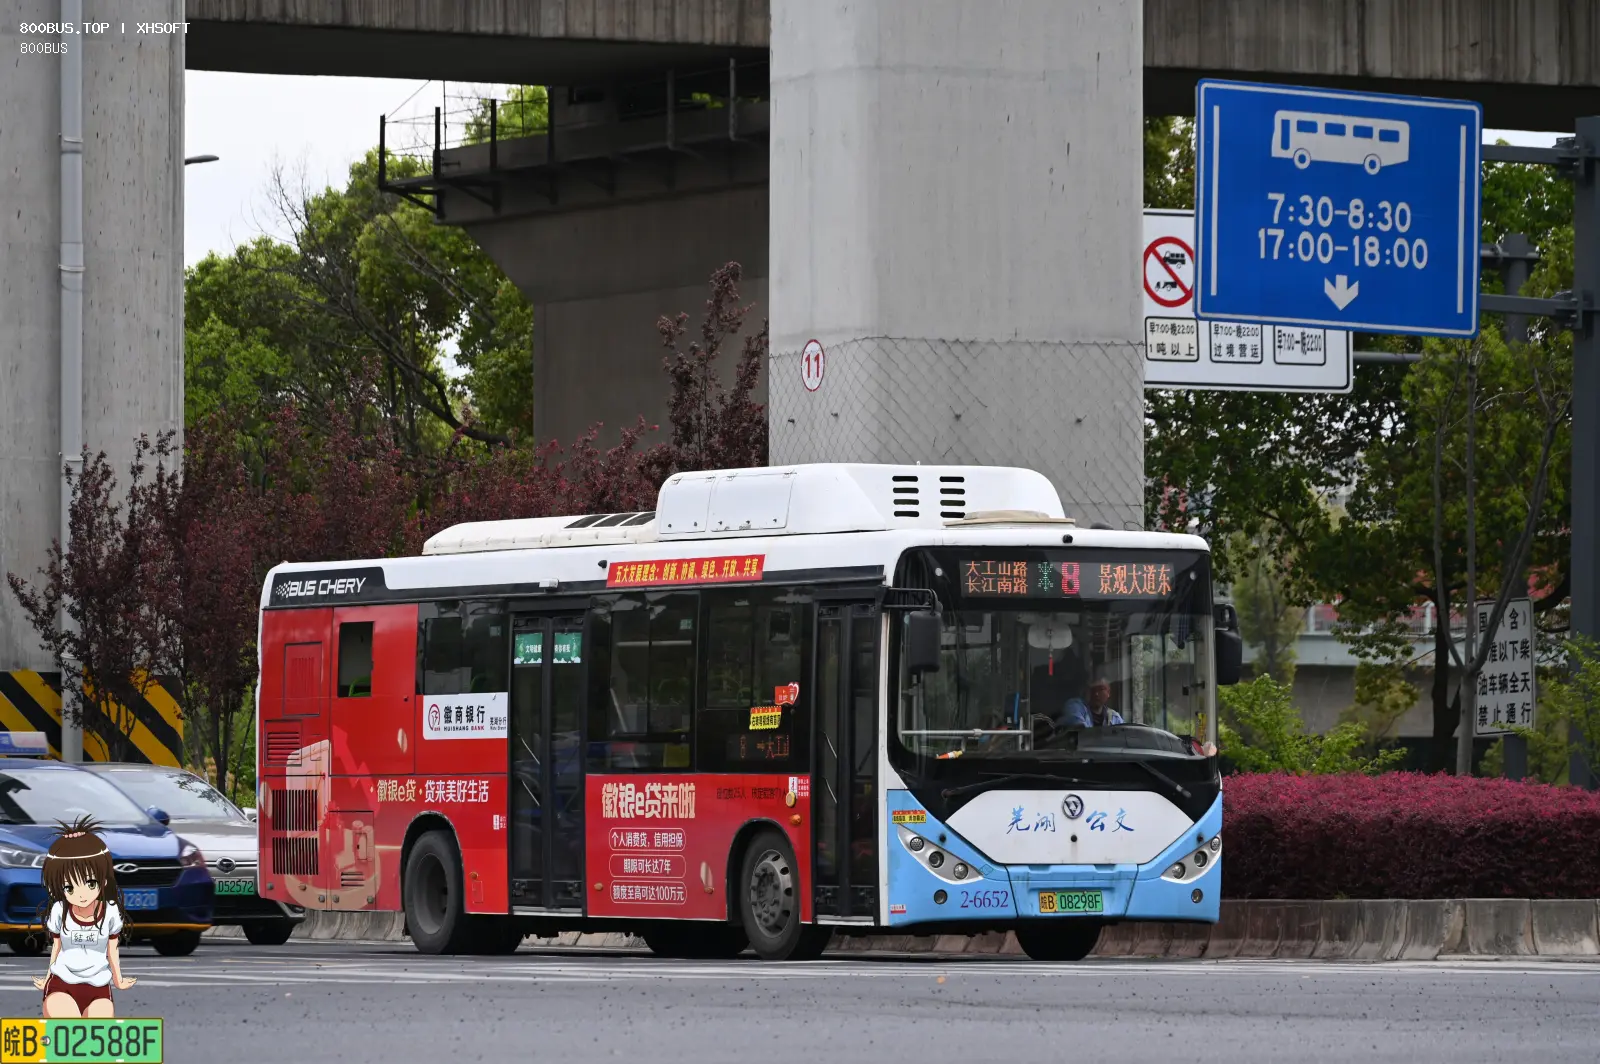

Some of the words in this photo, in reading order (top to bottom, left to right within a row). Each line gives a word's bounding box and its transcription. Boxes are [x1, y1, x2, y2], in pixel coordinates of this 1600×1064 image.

[1267, 192, 1412, 234] 7:30-8:30
[1258, 227, 1429, 270] 17:00-18:00
[1213, 343, 1260, 359] 过境营运
[805, 353, 820, 379] 11
[965, 561, 1028, 577] 大工山路
[1061, 562, 1081, 595] 8
[1098, 564, 1172, 595] 景观大道东
[288, 580, 318, 597] BUS
[318, 577, 367, 595] CHERY
[965, 577, 1028, 594] 长江南路
[1478, 671, 1531, 695] 油车辆全天
[443, 705, 486, 724] 徽商银行
[1478, 702, 1532, 726] 禁止通行
[377, 779, 416, 802] 徽银e贷
[424, 780, 489, 803] 贷来美好生活
[601, 782, 696, 819] 徽银e贷来啦
[1085, 808, 1135, 833] 公交
[623, 858, 671, 874] 期限可长达7年
[218, 880, 254, 893] D52572
[612, 885, 685, 901] 额度至高可达100万元
[960, 890, 1009, 908] 2-6652
[1060, 894, 1101, 909] 08298F
